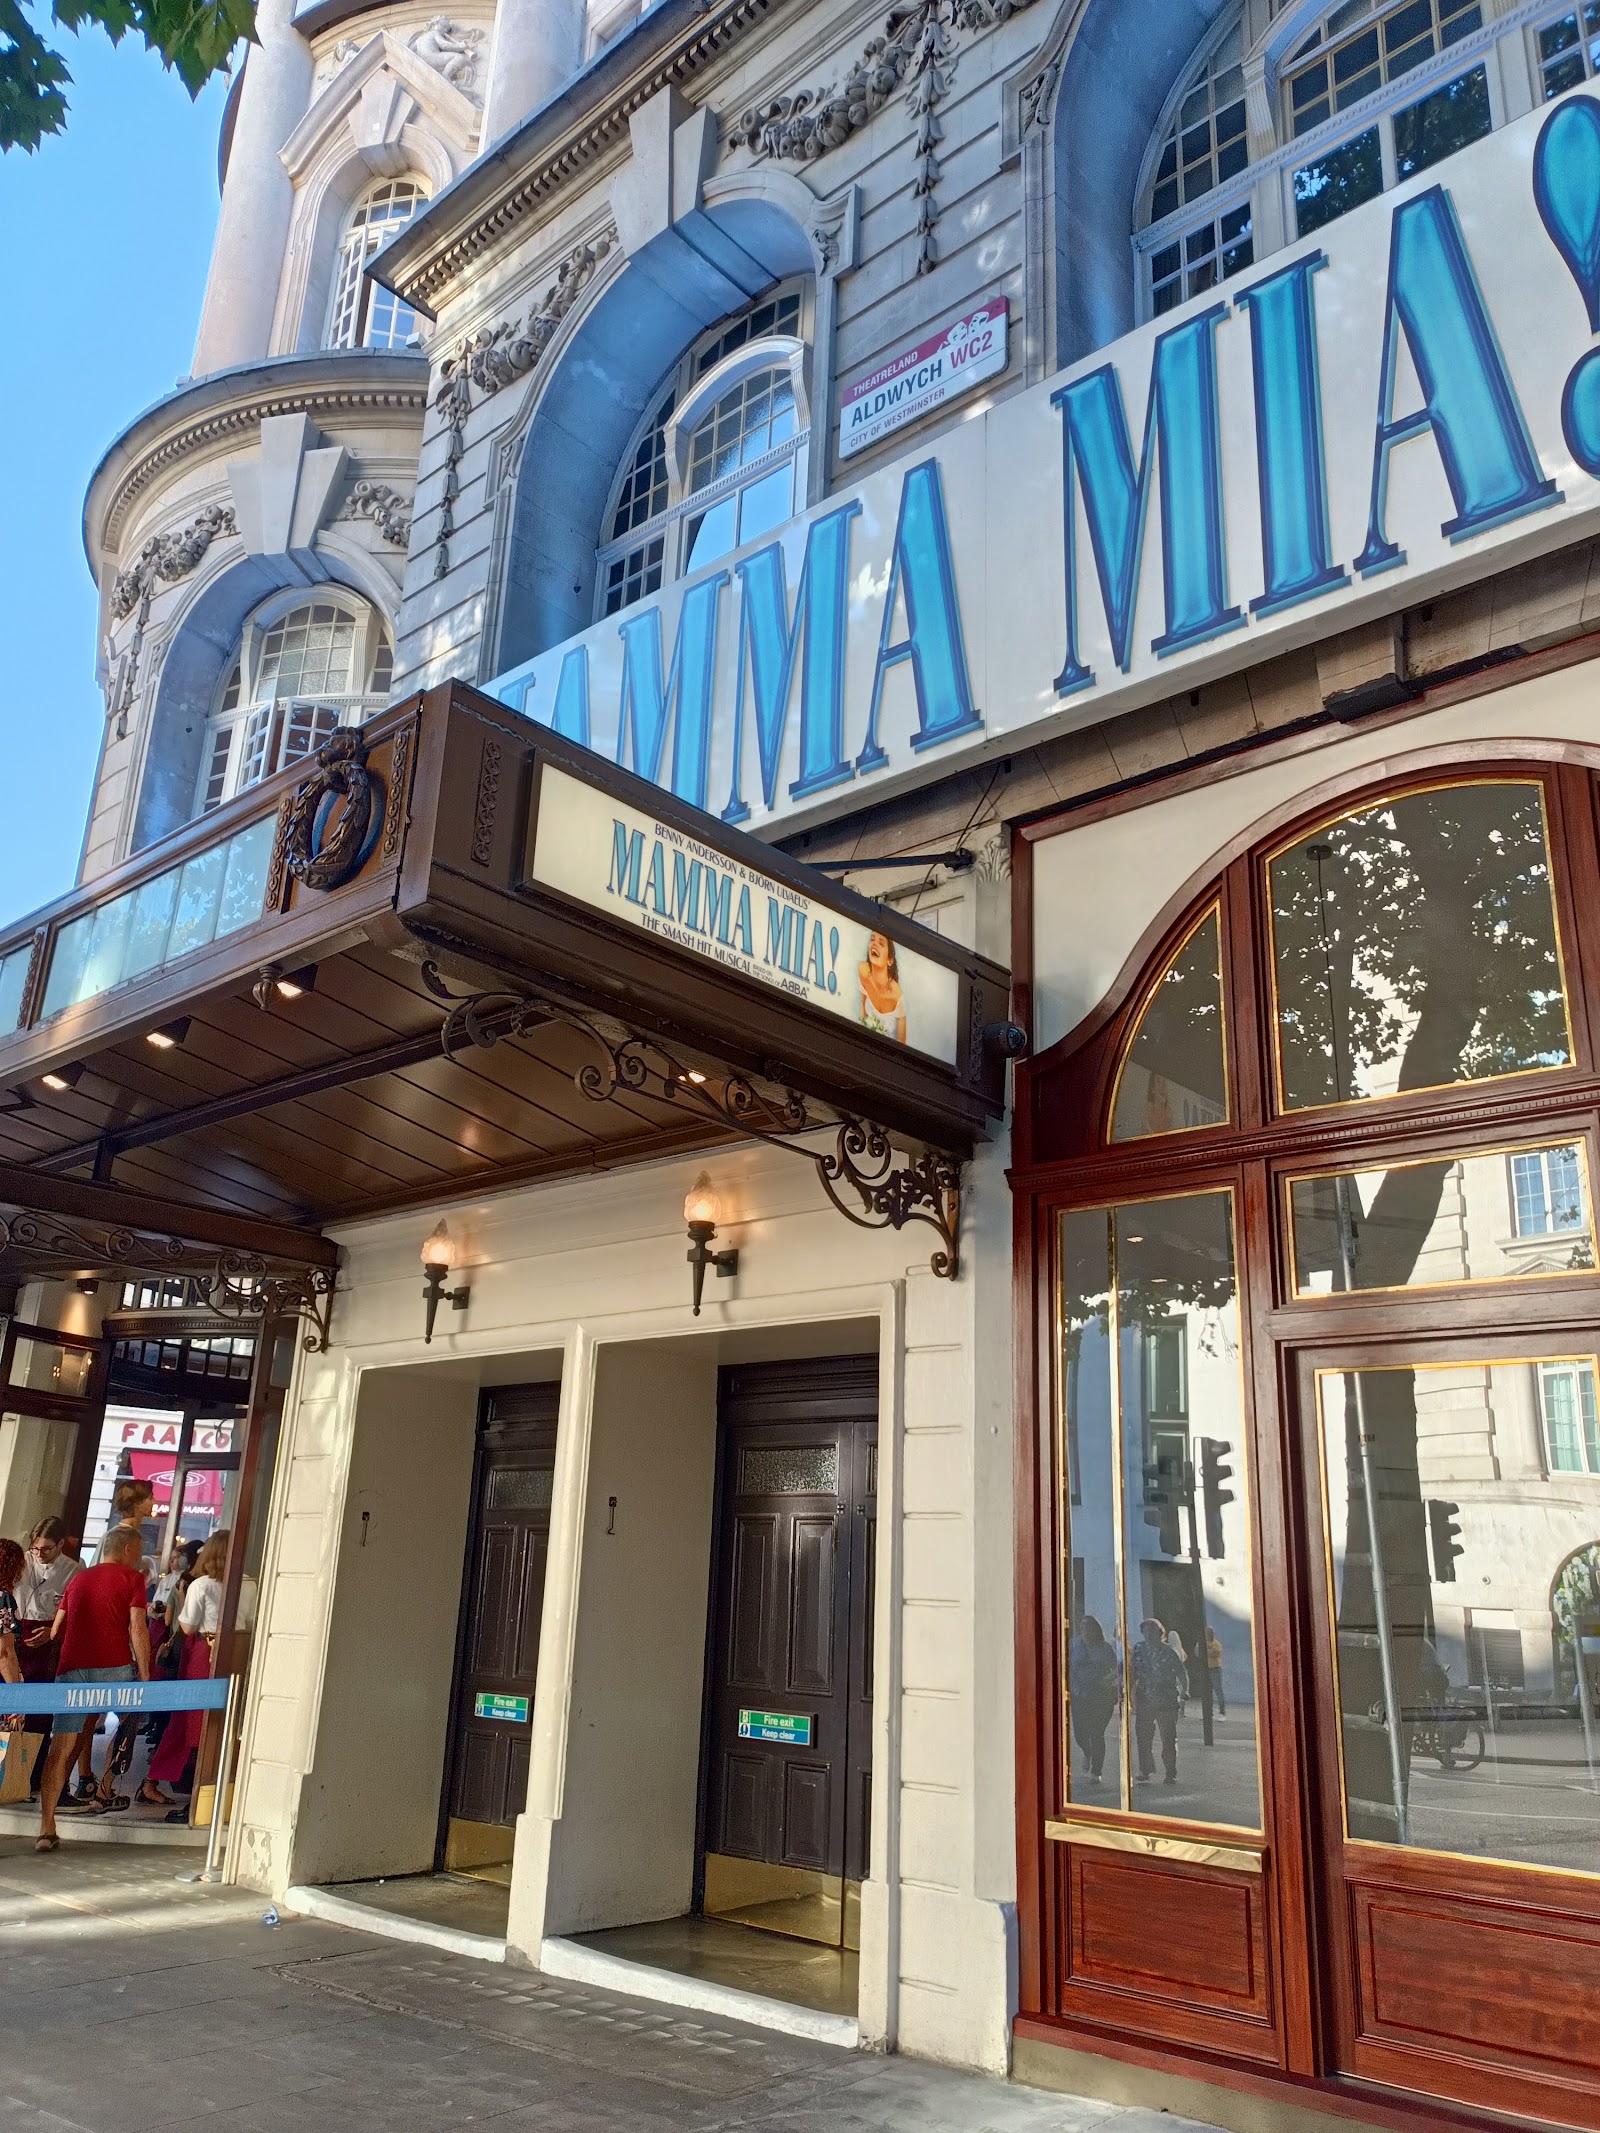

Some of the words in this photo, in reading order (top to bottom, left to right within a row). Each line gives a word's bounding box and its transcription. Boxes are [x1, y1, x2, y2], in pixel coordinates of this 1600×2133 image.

[851, 358, 942, 428] ALDWYCH
[950, 330, 993, 369] WC2
[853, 351, 919, 397] THEATRELAND
[1050, 94, 1600, 700] MIA!
[850, 431, 869, 448] CITY
[871, 424, 882, 437] OF
[883, 387, 946, 429] WESTMINSTER
[655, 823, 685, 847] BENNY
[686, 840, 738, 875] ANDERSSON
[739, 867, 747, 879] &
[748, 872, 776, 893] BJÖRN
[606, 818, 755, 959] MAMMA
[763, 896, 840, 996] MIA!
[641, 913, 661, 932] THE
[662, 923, 695, 947] SMASH
[697, 939, 713, 955] HIT
[714, 946, 752, 974] MUSICAL
[781, 978, 808, 999] ABBA
[121, 1423, 229, 1449] FRACO
[65, 1688, 112, 1708] MAMMA
[114, 1687, 145, 1707] MIA!
[491, 1708, 504, 1717] Keep
[505, 1710, 517, 1718] clear
[494, 1697, 505, 1706] Fire
[506, 1699, 517, 1707] exit
[762, 1728, 778, 1739] Keep
[779, 1731, 796, 1740] clear
[764, 1715, 779, 1726] Fire
[779, 1718, 795, 1728] exit
